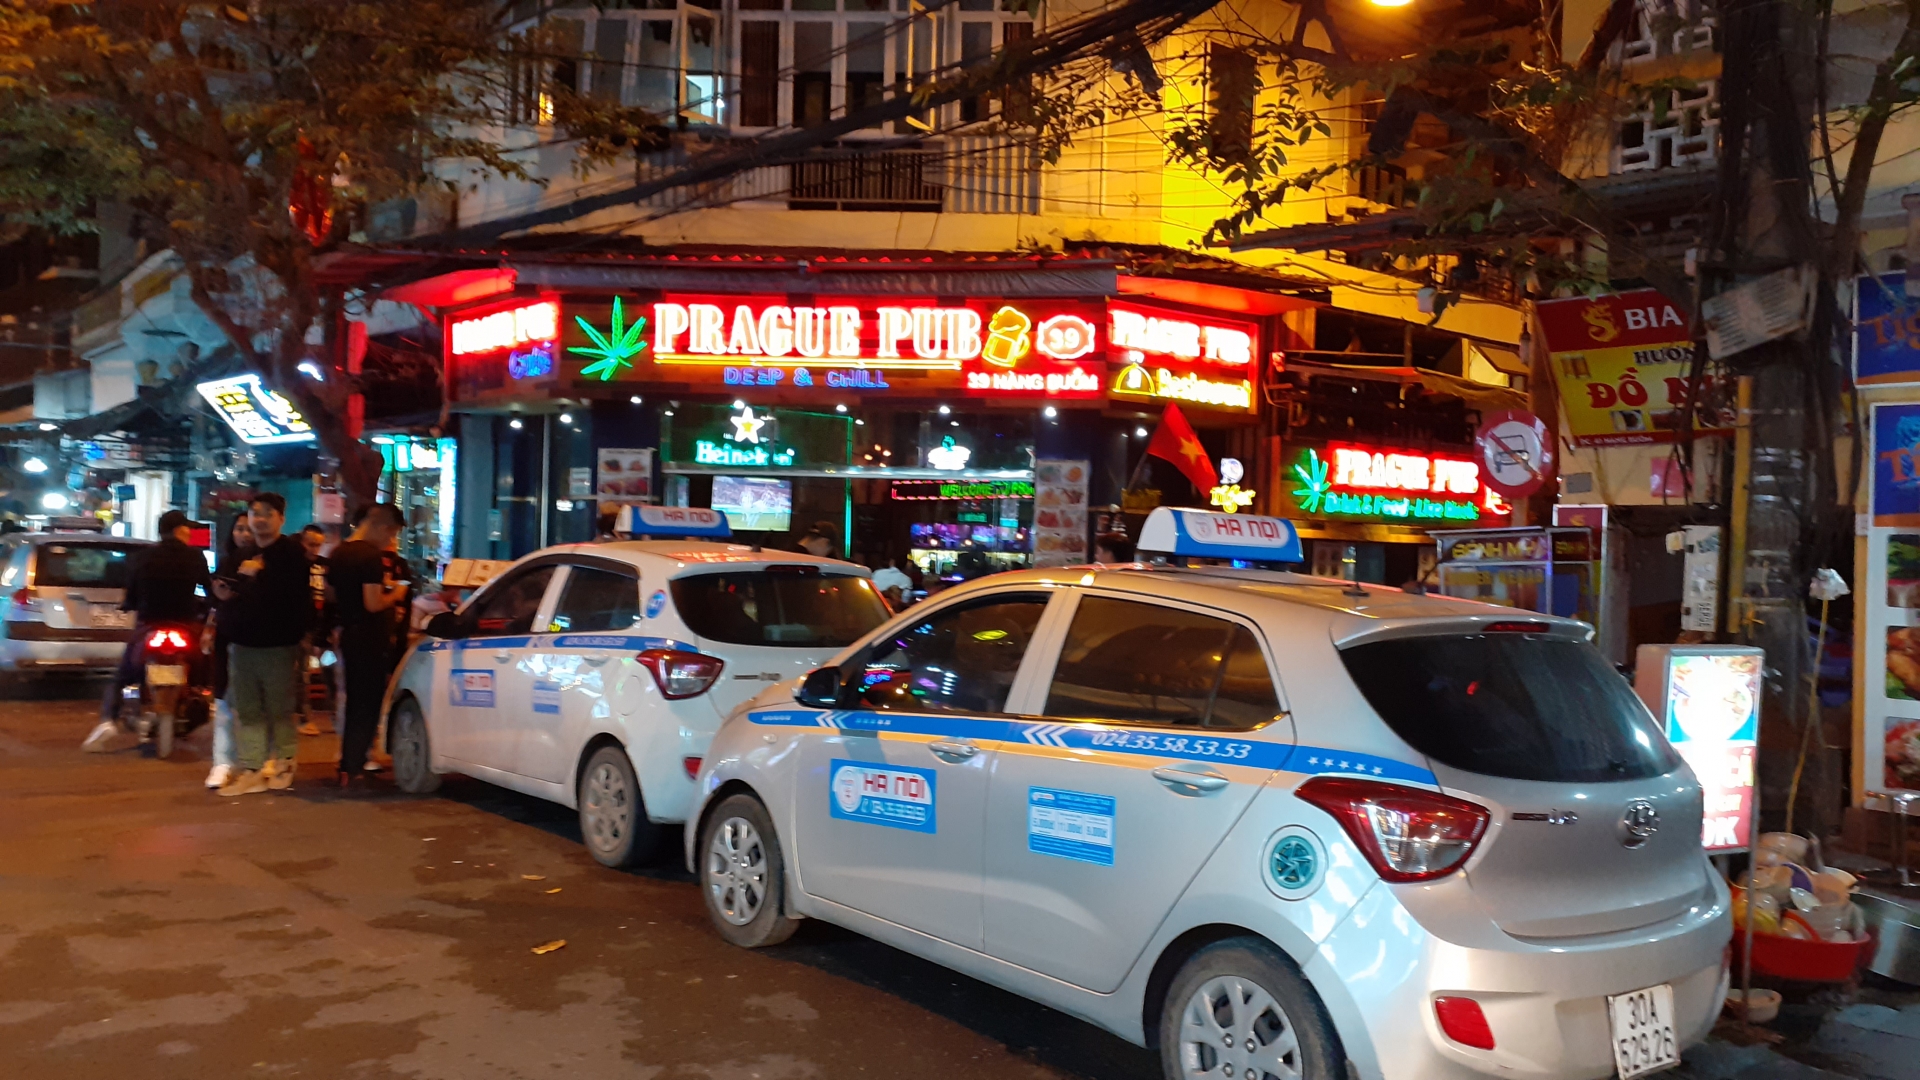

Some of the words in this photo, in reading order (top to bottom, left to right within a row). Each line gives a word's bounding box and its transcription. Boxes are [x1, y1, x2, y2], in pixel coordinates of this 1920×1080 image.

[654, 303, 860, 357] PRAGUE
[877, 307, 982, 359] PUB
[1624, 305, 1683, 330] BIA
[1049, 328, 1080, 349] 39
[724, 366, 785, 386] DEEP
[794, 366, 813, 386] &
[826, 369, 889, 388] CHILL
[968, 372, 990, 389] 39
[993, 370, 1044, 389] HÀNG
[1586, 367, 1648, 408] ĐỒ
[1335, 449, 1429, 489] PRAGUE
[1433, 459, 1478, 493] PUB
[1092, 732, 1252, 759] 024.35.58.53.53
[1628, 991, 1659, 1029] 30A
